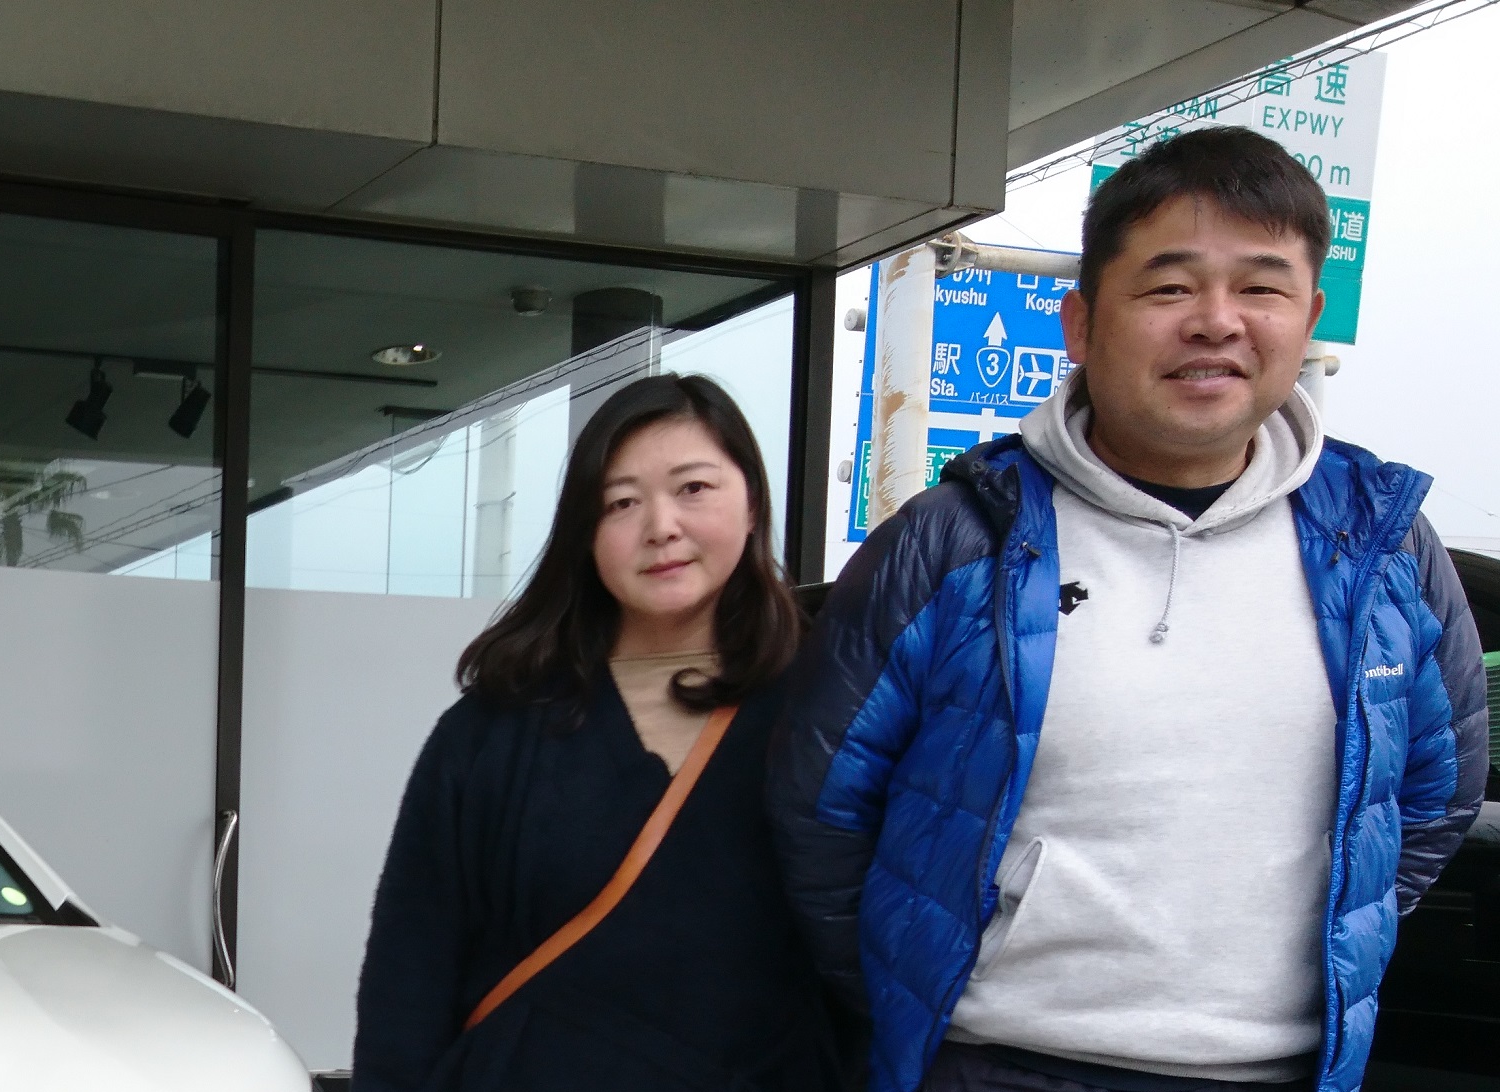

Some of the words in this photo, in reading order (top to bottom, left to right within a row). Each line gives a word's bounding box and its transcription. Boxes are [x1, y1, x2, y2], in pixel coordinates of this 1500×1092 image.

[1262, 105, 1344, 138] EXPWY
[1025, 292, 1061, 315] Koga
[932, 342, 961, 375] 駅
[986, 353, 999, 376] 3
[930, 377, 958, 397] Sta.
[970, 391, 1009, 405] バイパス
